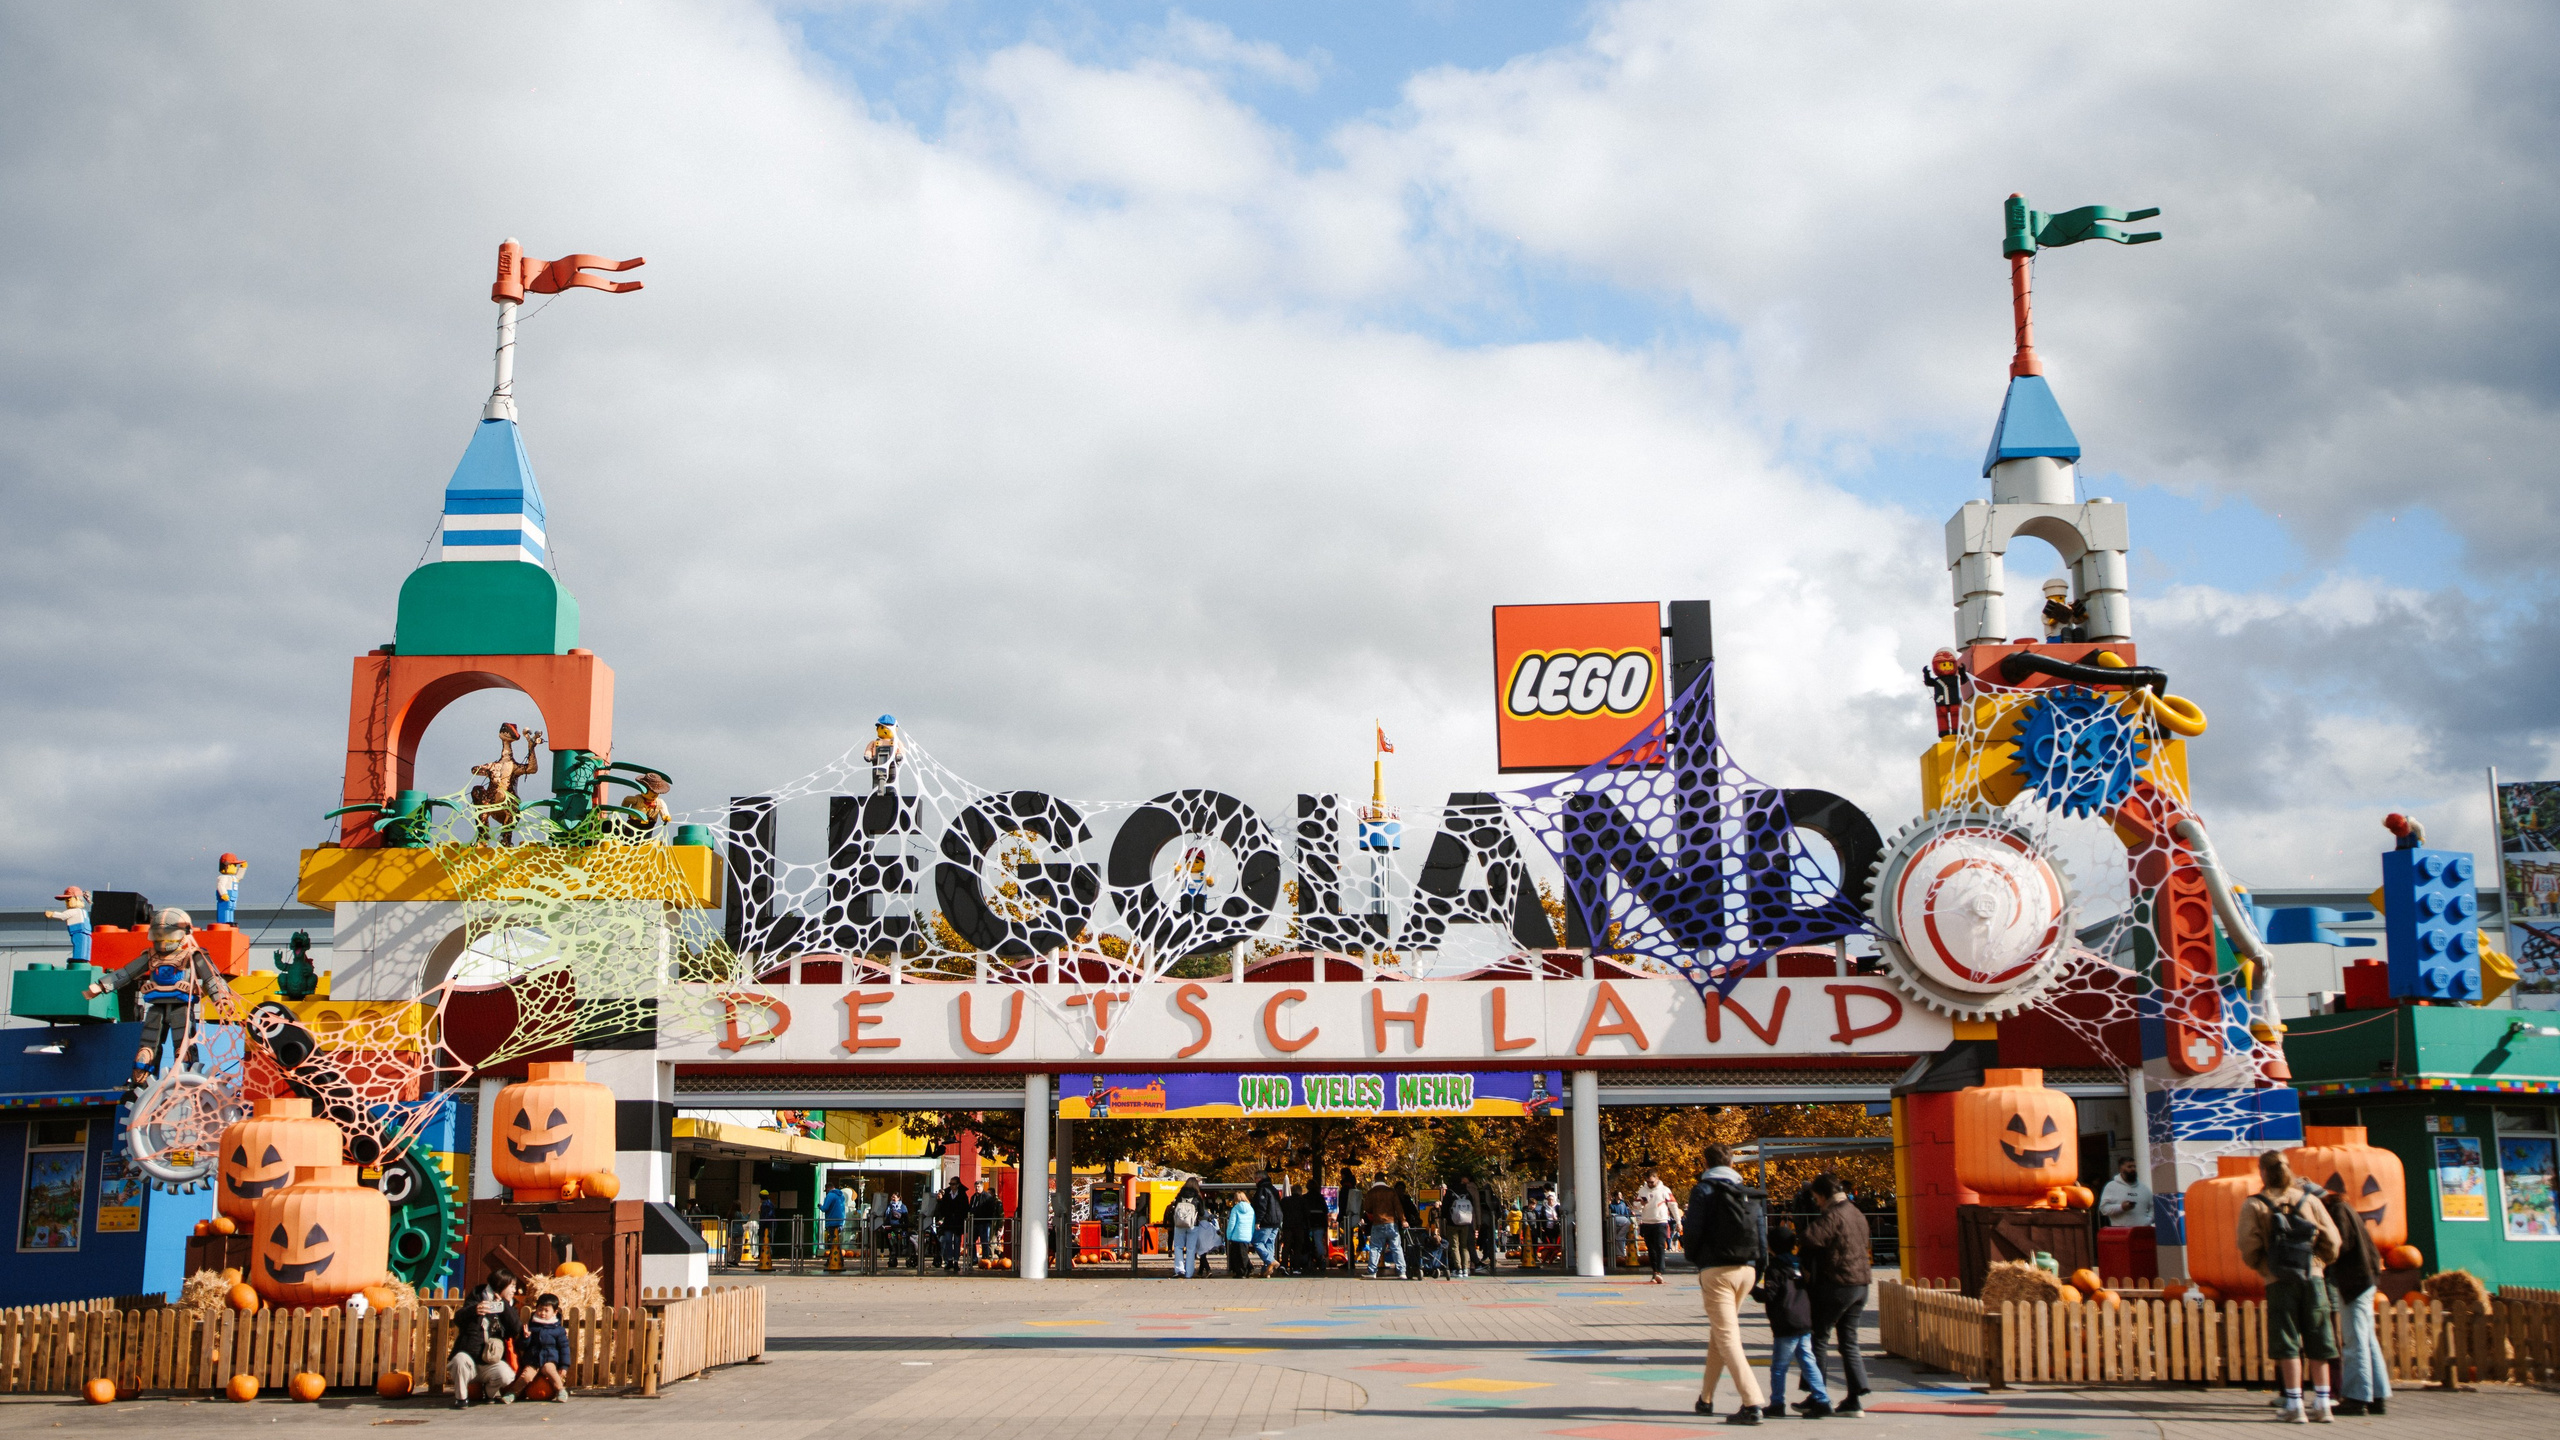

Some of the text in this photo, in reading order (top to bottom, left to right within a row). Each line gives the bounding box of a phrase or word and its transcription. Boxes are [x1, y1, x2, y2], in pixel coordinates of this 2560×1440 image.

[499, 251, 512, 275] LEGO
[1508, 651, 1653, 716] LEGO
[725, 600, 1885, 957] LEGOLAND
[717, 981, 1903, 1058] DEUTSCHLAND
[1240, 1076, 1472, 1112] UND VIELES MEHR!
